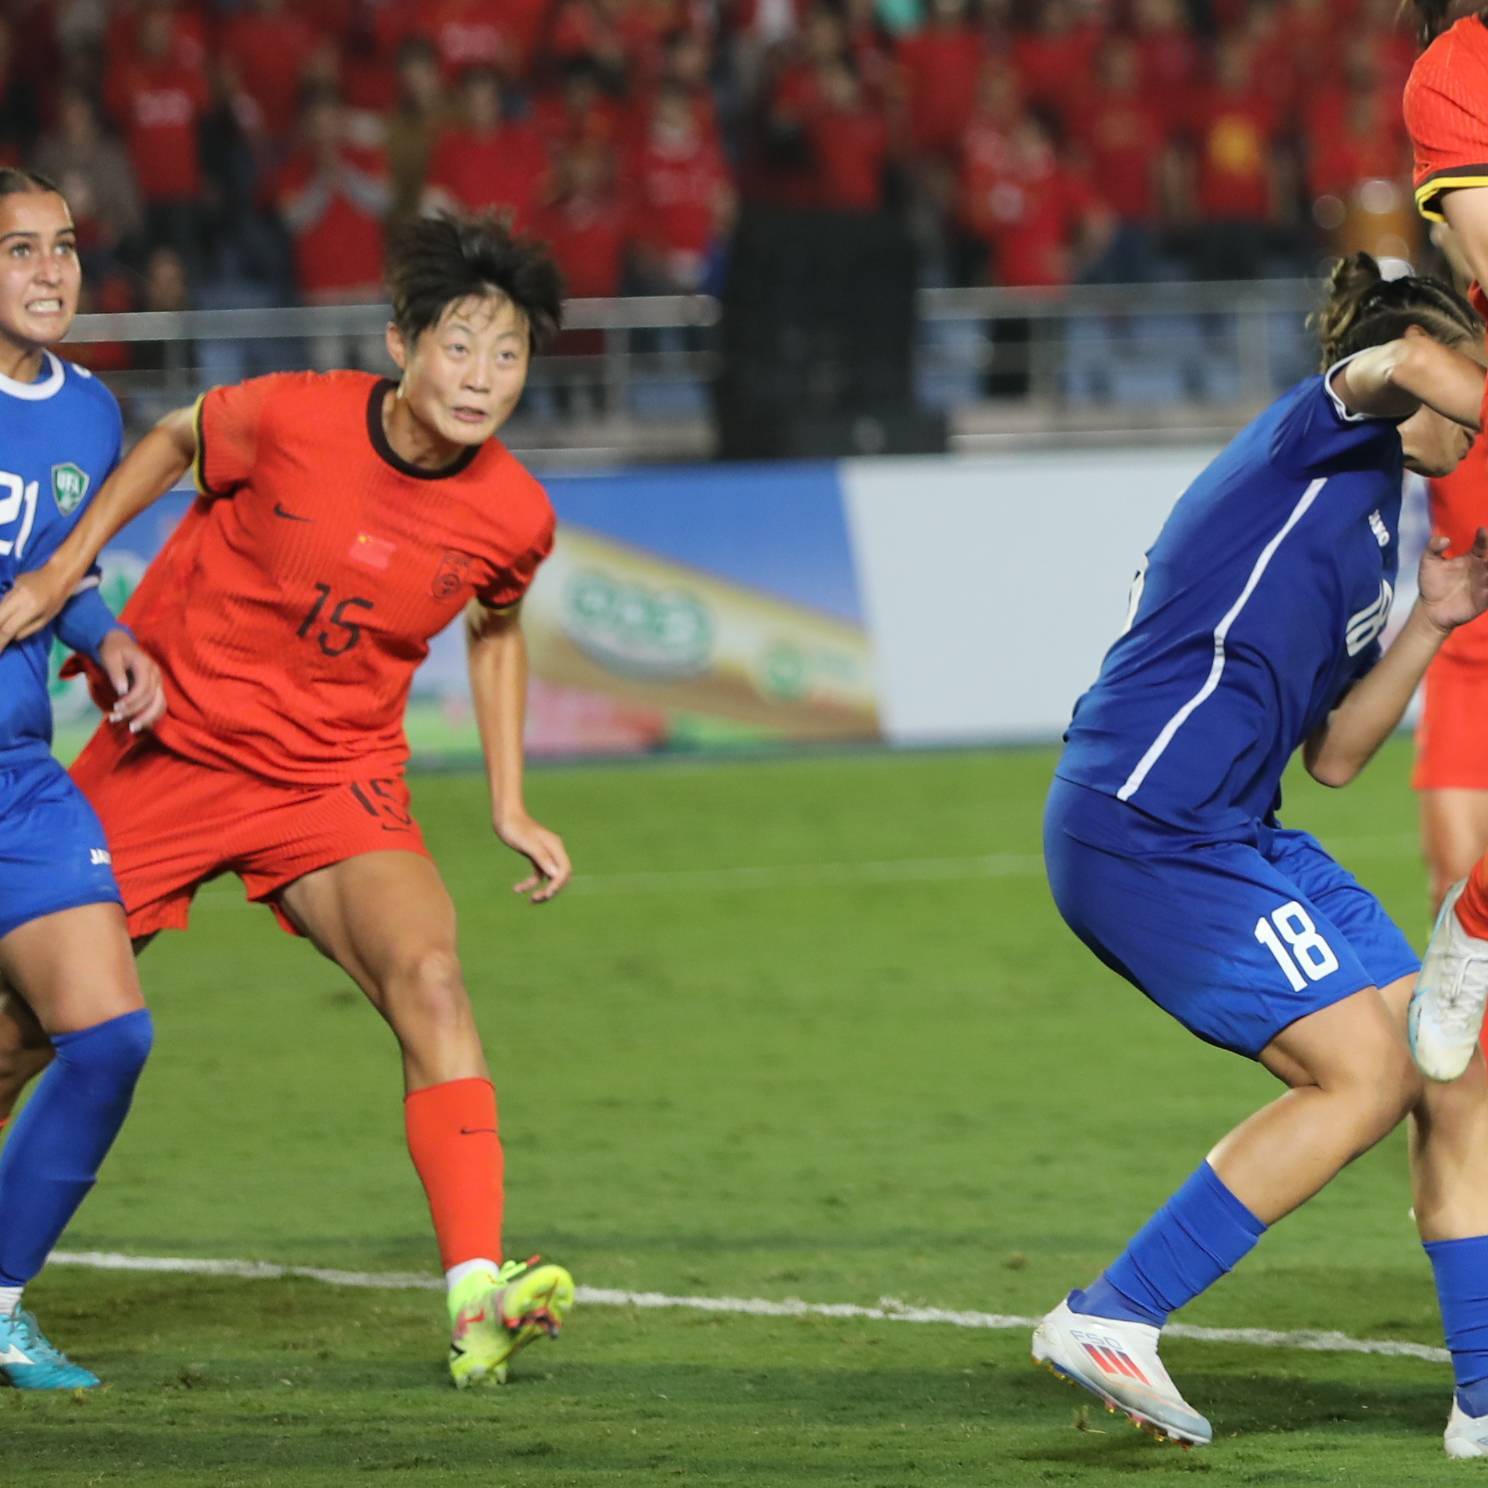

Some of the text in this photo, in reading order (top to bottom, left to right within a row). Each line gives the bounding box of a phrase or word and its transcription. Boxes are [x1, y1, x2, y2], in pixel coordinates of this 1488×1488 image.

[297, 581, 374, 657] 15
[1346, 578, 1393, 651] 18
[1254, 900, 1340, 993] 18
[1070, 1329, 1123, 1350] F50
